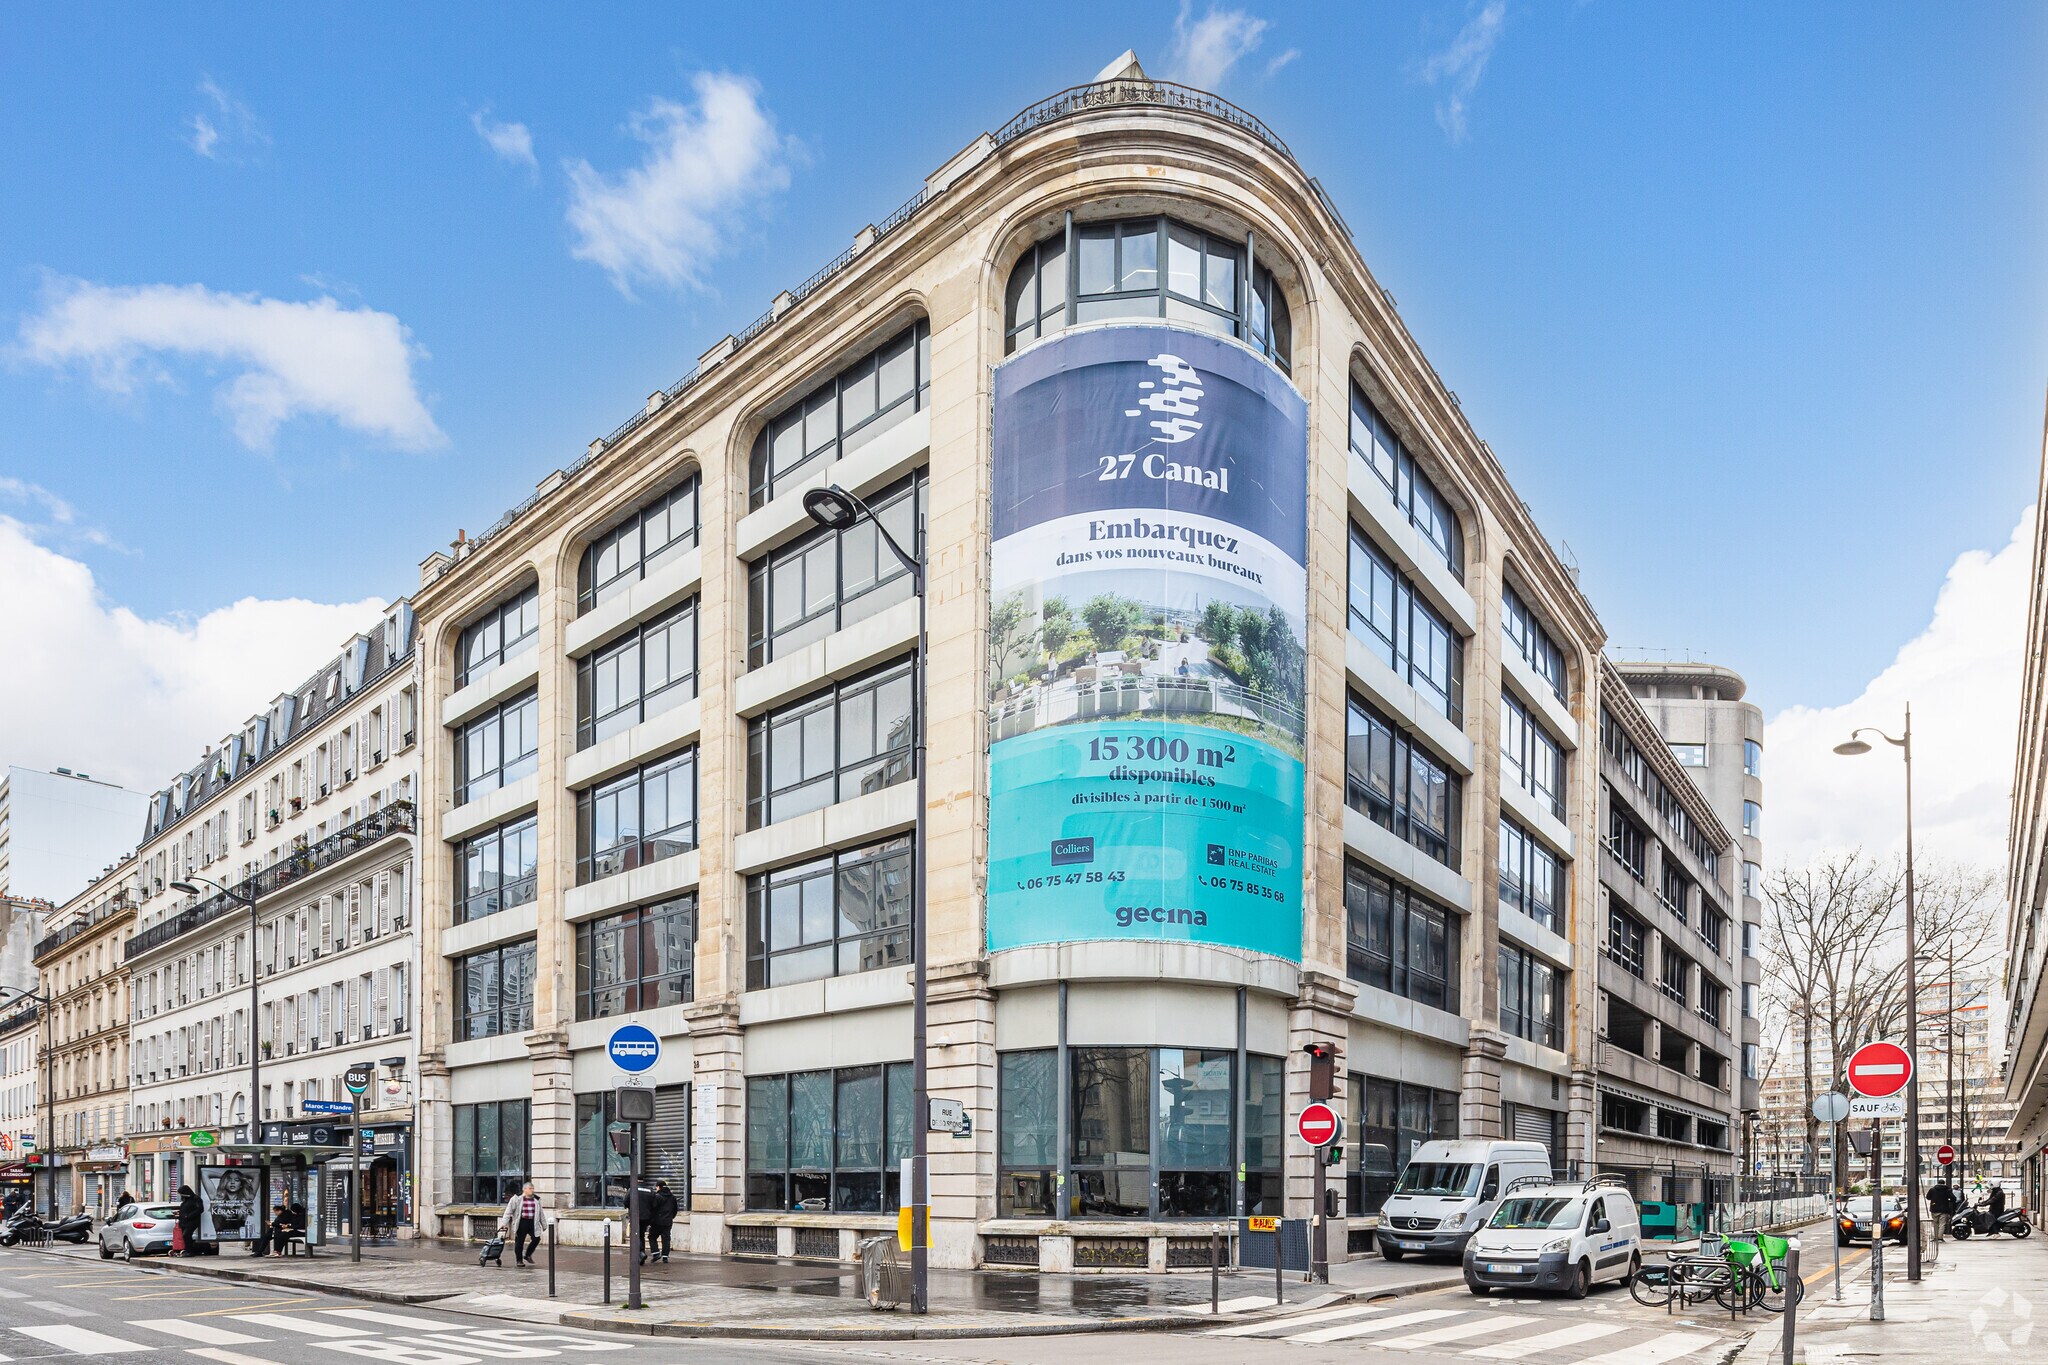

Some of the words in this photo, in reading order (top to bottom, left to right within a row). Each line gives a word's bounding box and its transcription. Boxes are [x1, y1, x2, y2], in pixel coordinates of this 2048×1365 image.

[1098, 453, 1136, 481] 27
[1142, 453, 1229, 494] Canal
[1088, 517, 1239, 555] Embarquez
[1056, 552, 1093, 567] dans
[1097, 548, 1122, 560] vos
[1126, 548, 1204, 565] nouveaux
[1207, 553, 1263, 585] bureaux
[1088, 736, 1119, 762] 15
[1126, 735, 1190, 763] 300
[1109, 764, 1216, 788] disponibles
[1071, 791, 1131, 805] divisibles
[1133, 791, 1141, 802] à
[1144, 793, 1182, 805] partir
[1184, 795, 1199, 806] de
[1201, 796, 1207, 807] 1
[1209, 798, 1231, 811] 500
[1055, 843, 1090, 855] Colliers
[1228, 848, 1247, 859] BNP
[1248, 852, 1278, 869] PARIBAS
[1228, 858, 1250, 870] REAL
[1251, 863, 1276, 878] ESTATE
[1027, 877, 1043, 890] 06
[1046, 875, 1061, 887] 75
[1065, 873, 1082, 885] 47
[1085, 871, 1103, 883] 58
[1107, 870, 1126, 882] 43
[1210, 876, 1227, 889] 06
[1229, 879, 1244, 892] 75
[1246, 882, 1259, 895] 85
[1261, 886, 1272, 899] 35
[1274, 890, 1285, 903] 68
[1115, 906, 1207, 928] gecina
[348, 1073, 367, 1083] BUS
[941, 1108, 953, 1117] RUE
[1852, 1104, 1880, 1113] SAUF
[362, 1130, 374, 1138] 54
[211, 1206, 251, 1215] KÉRASTASE
[305, 1329, 635, 1365] BUS
